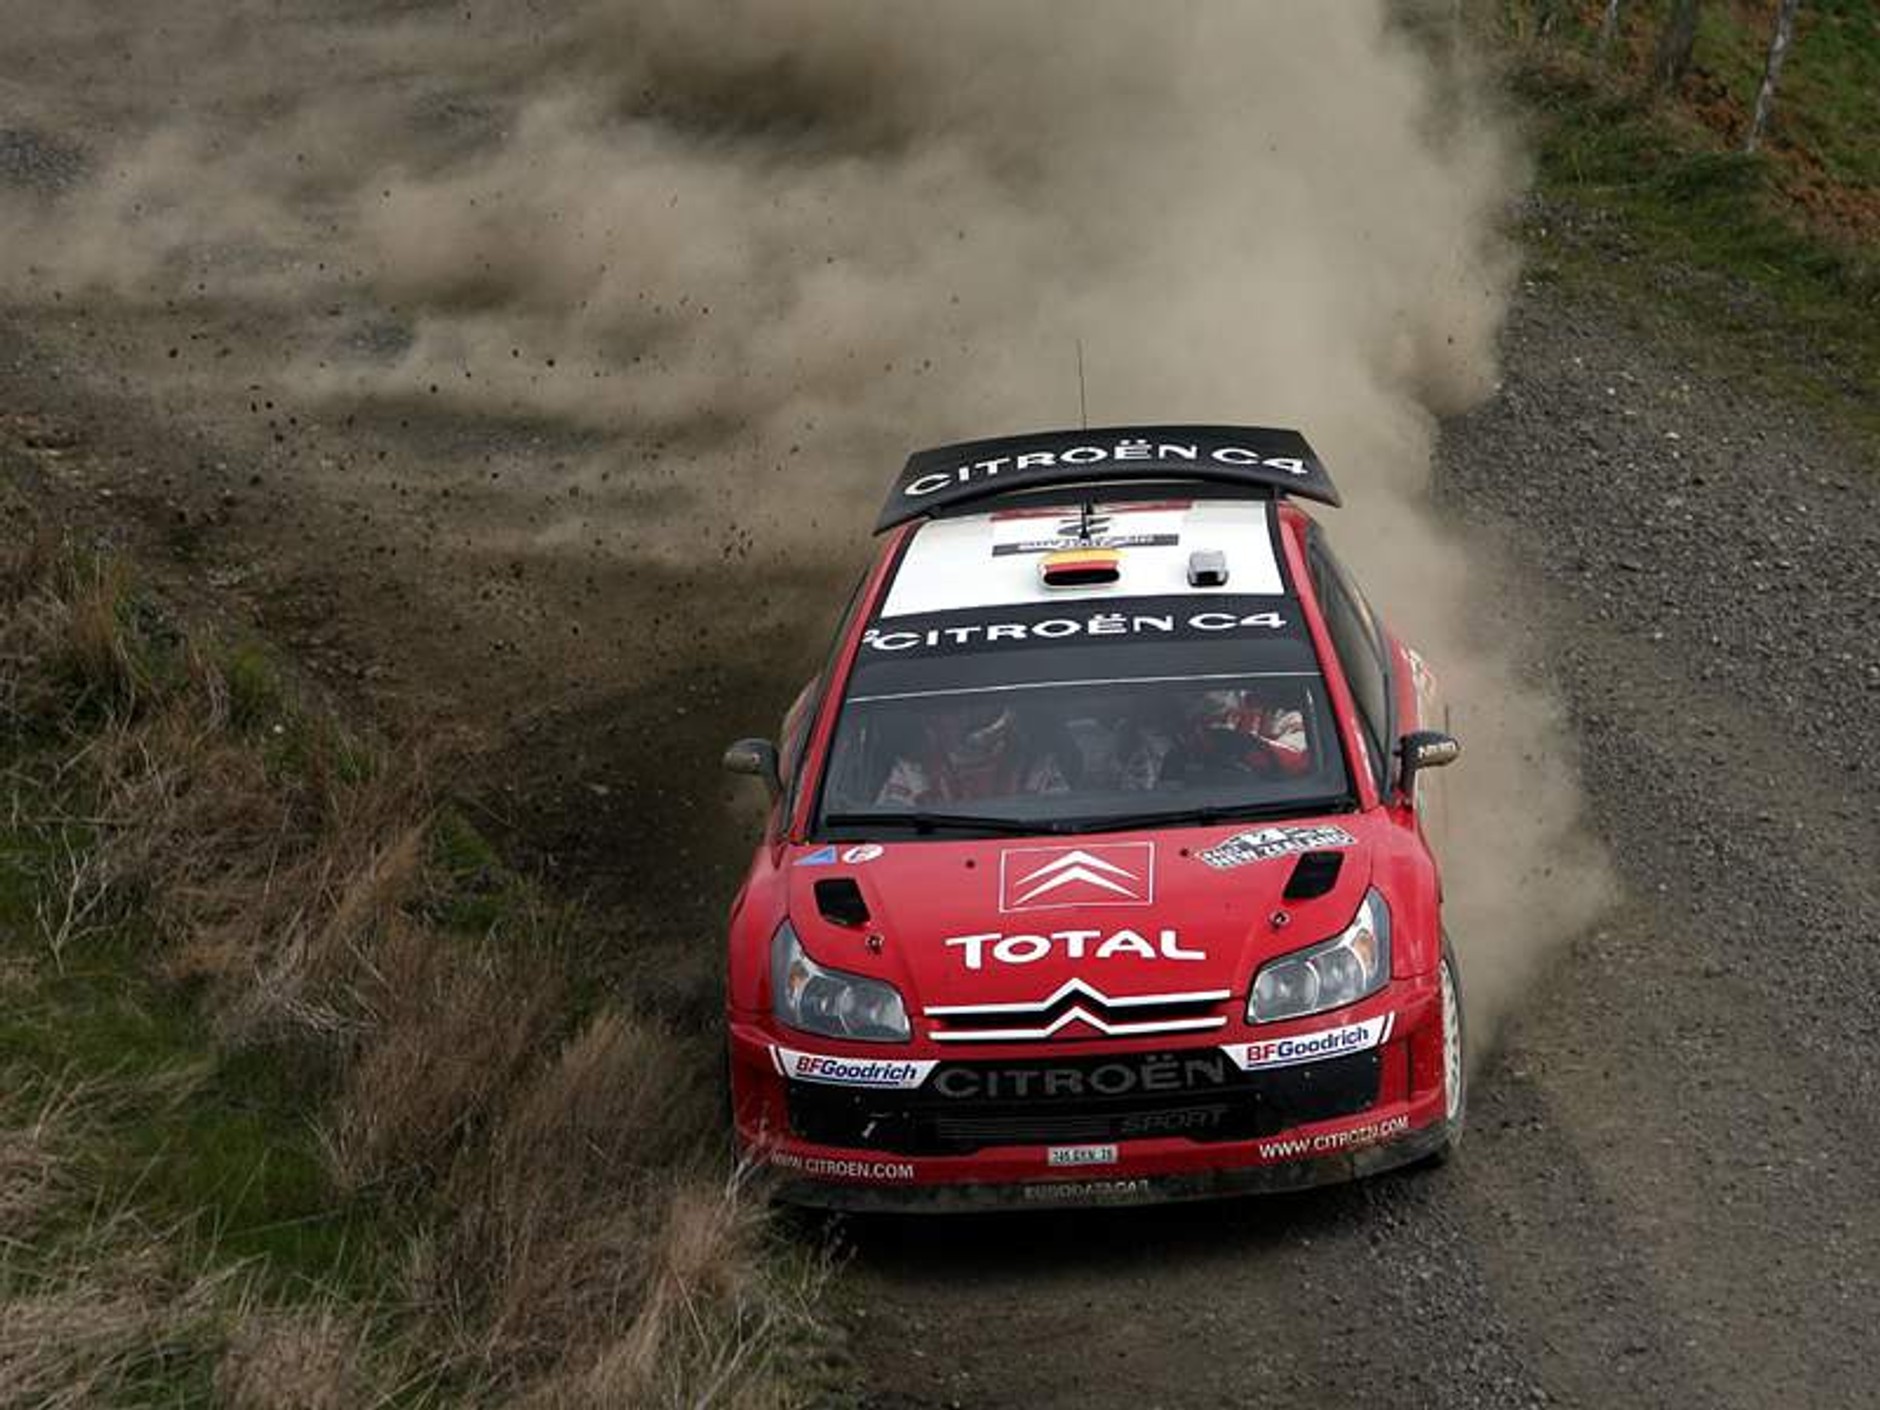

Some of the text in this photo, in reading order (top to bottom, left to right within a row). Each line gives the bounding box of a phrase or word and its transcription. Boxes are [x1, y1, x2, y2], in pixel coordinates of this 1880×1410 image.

[904, 439, 1308, 496] CITROËN C4
[871, 612, 1287, 652] CITROËN C4
[945, 929, 1206, 969] TOTAL
[1246, 1025, 1369, 1063] BFGoodrich
[795, 1055, 917, 1082] BFGoodrich
[934, 1054, 1226, 1098] CITROËN
